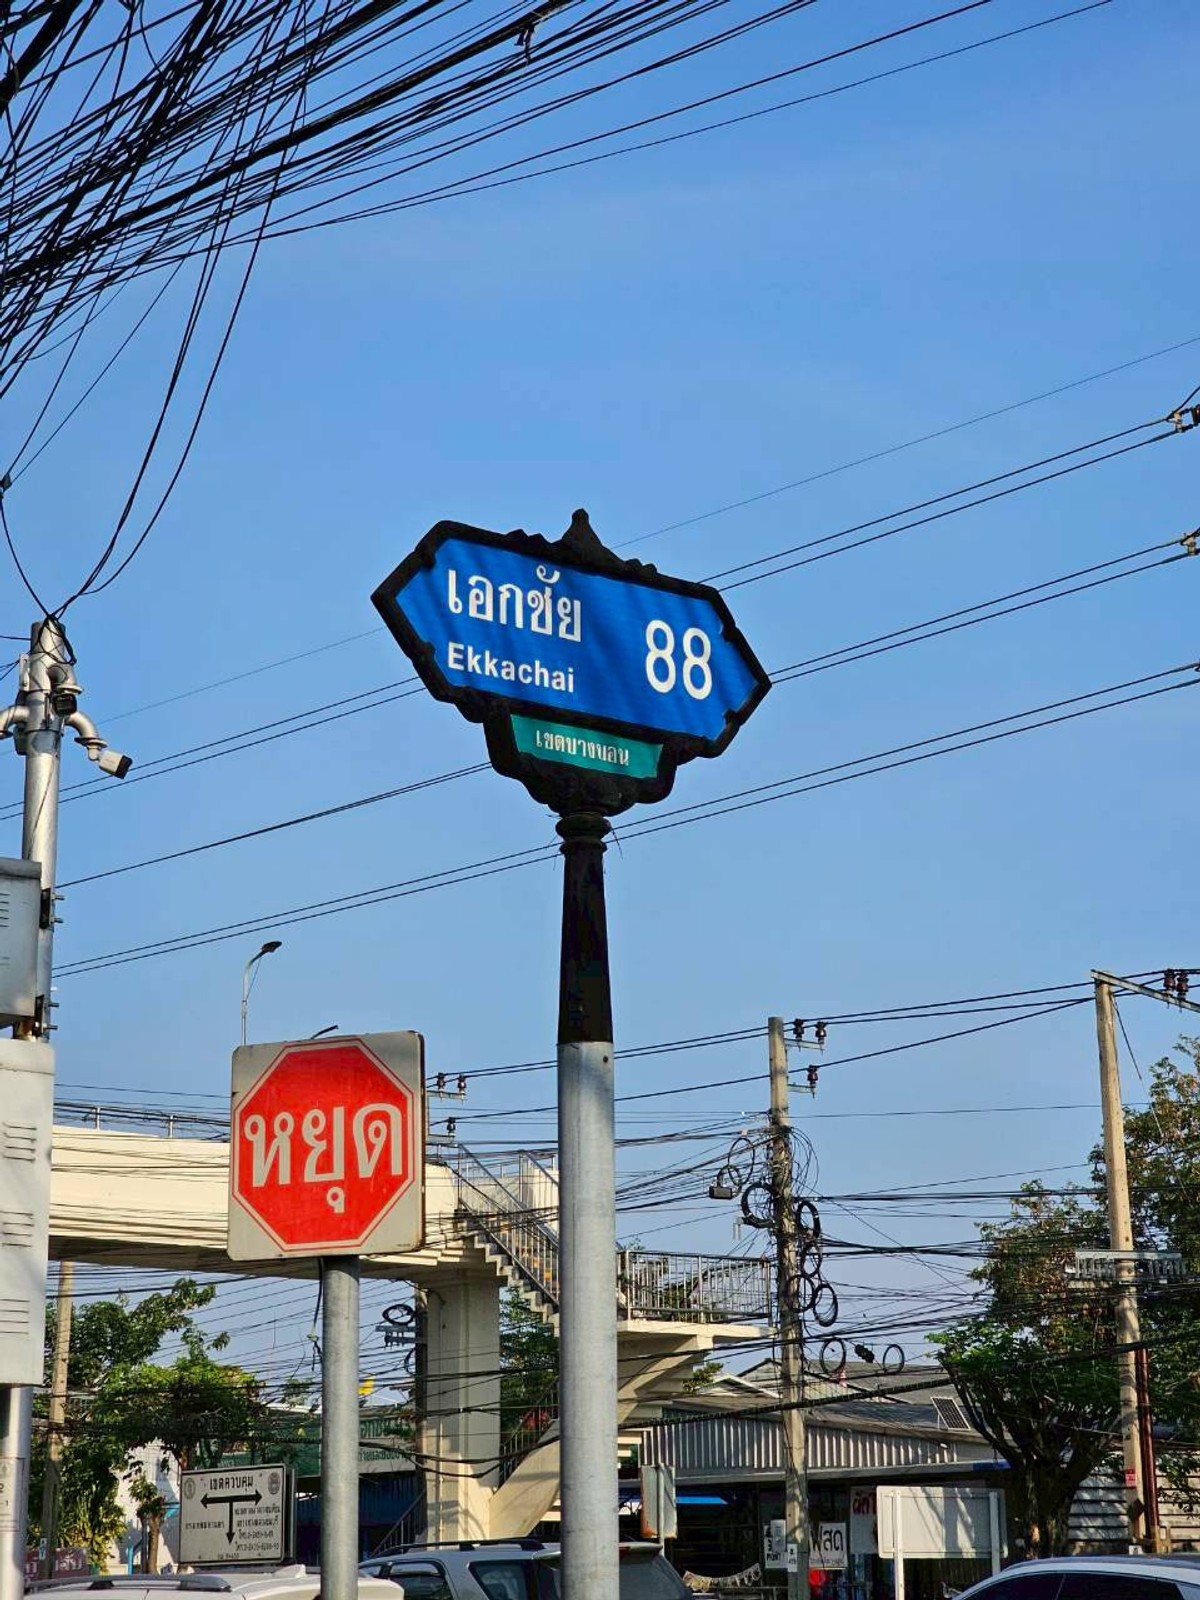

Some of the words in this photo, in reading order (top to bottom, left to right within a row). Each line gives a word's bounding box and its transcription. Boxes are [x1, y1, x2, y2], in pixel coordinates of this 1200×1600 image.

[447, 563, 582, 643] เอกชัย
[644, 619, 713, 701] 88
[447, 640, 575, 693] Ekkachai
[536, 730, 630, 766] เขตบางบอน
[244, 1103, 403, 1214] หยุด
